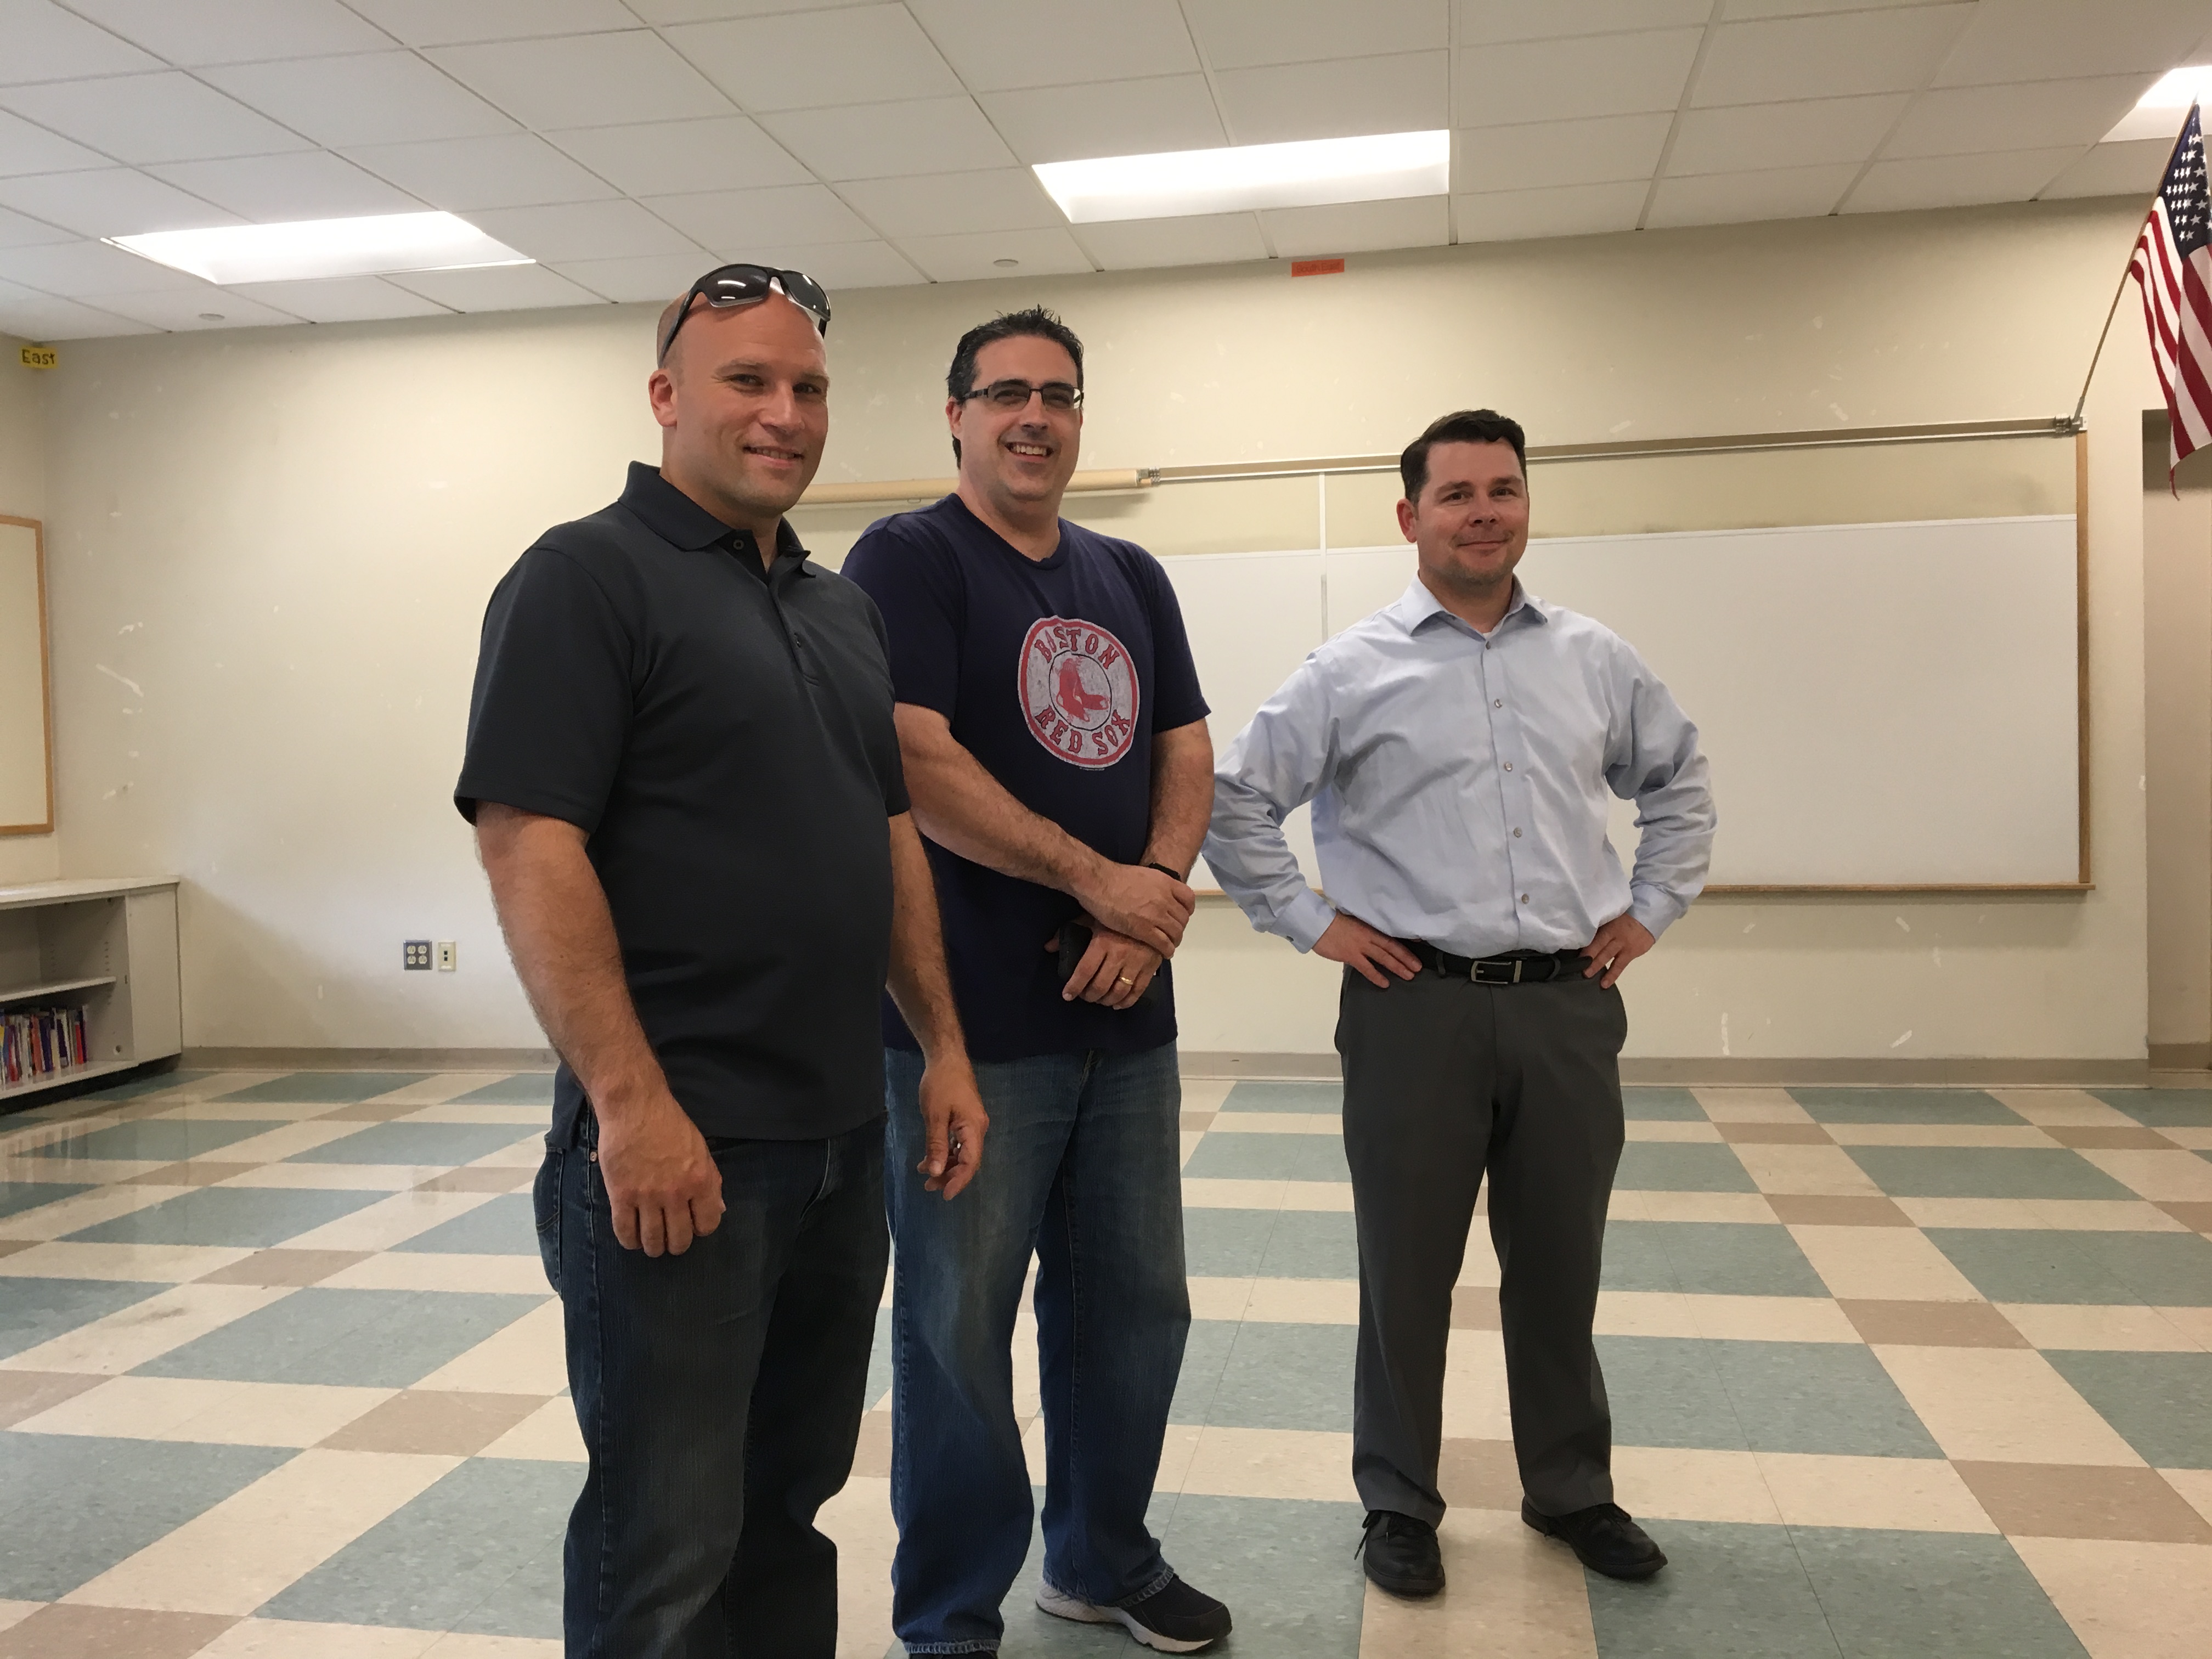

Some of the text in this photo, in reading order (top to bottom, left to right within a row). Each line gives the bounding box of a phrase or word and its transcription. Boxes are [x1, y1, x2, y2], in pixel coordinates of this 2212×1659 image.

[22, 349, 55, 365] East
[1035, 705, 1130, 755] RED SOX
